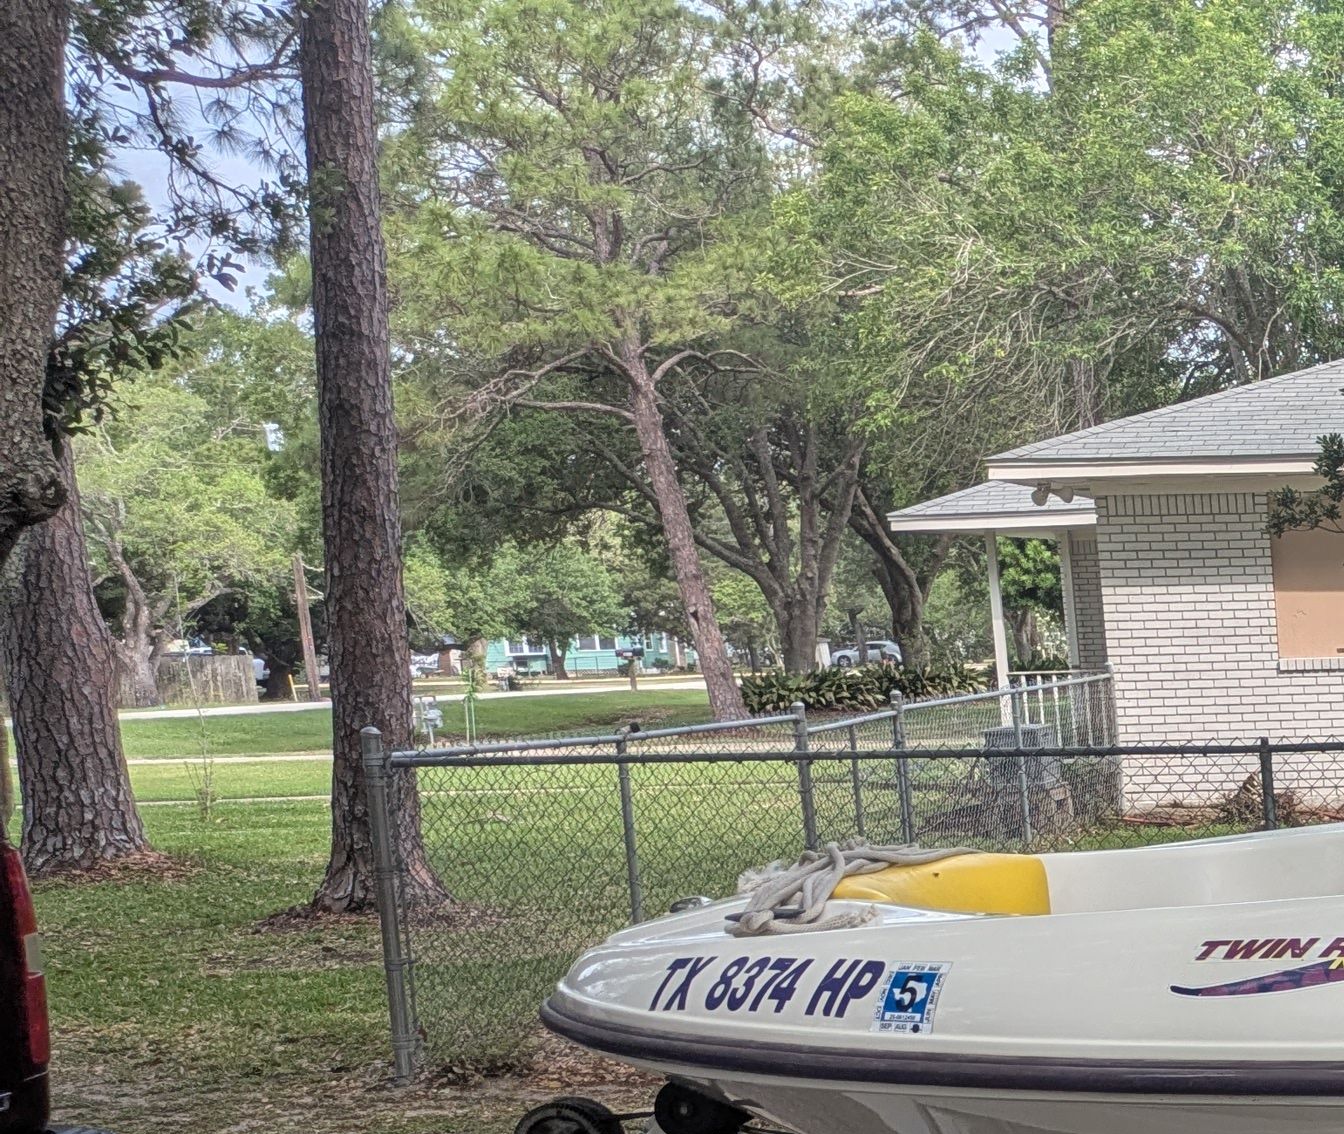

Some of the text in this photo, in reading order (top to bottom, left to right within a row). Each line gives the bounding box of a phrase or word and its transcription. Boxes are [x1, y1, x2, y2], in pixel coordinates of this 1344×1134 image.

[1195, 937, 1321, 961] TWIN
[648, 956, 886, 1018] TX 8374 HP
[895, 975, 923, 1012] 5
